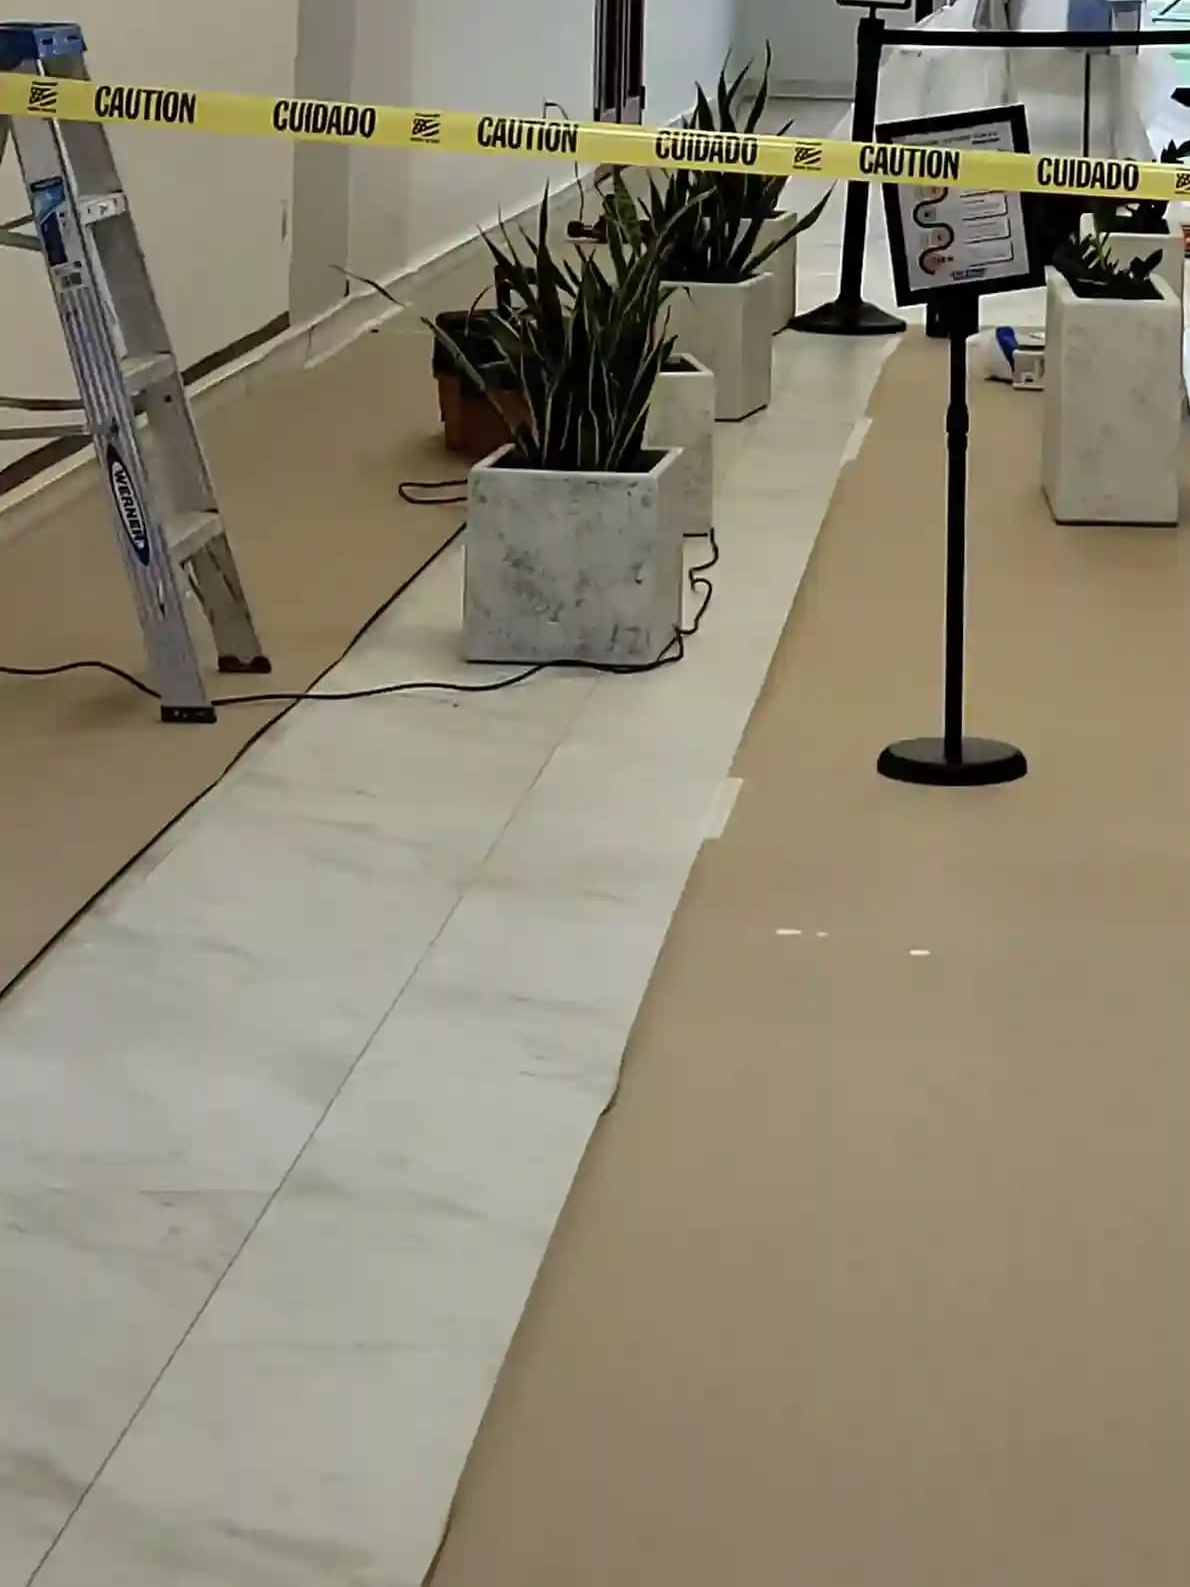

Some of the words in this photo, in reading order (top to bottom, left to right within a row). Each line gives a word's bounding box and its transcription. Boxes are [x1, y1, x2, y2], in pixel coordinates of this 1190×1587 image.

[94, 85, 197, 124] CAUTION
[273, 100, 375, 139] CUIDADO
[477, 116, 579, 153] CAUTION
[655, 130, 758, 166] CUIDADO
[859, 144, 961, 181] CAUTION
[1038, 157, 1140, 191] CUIDADO
[114, 468, 146, 542] WERNER
